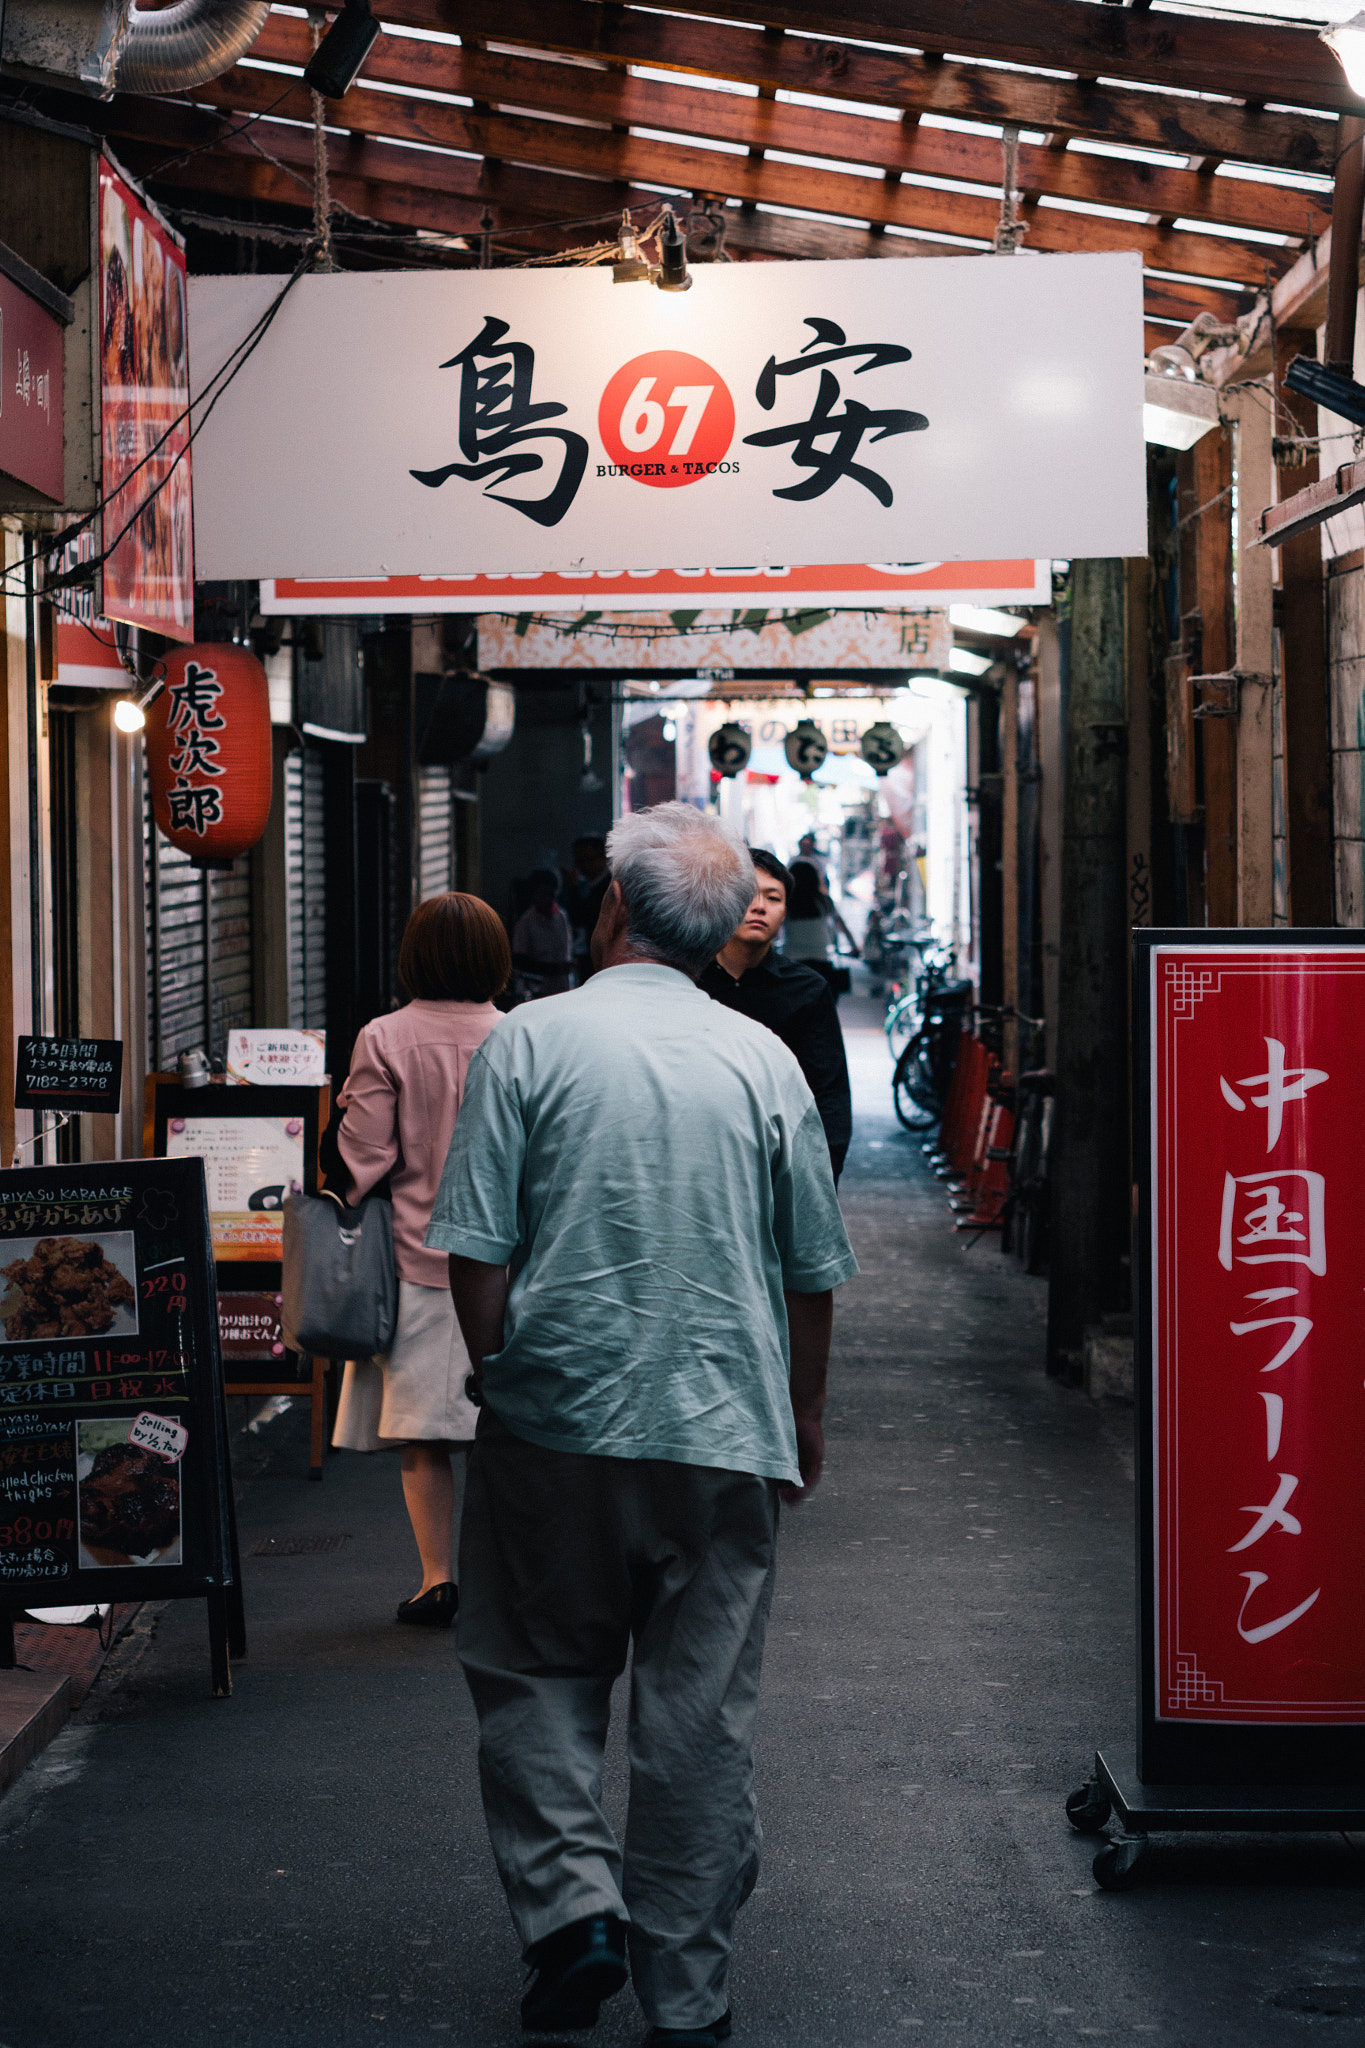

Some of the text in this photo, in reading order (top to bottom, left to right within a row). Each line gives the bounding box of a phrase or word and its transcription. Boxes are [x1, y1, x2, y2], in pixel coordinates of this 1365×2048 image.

[409, 316, 589, 527] 鳥
[618, 376, 715, 456] 67
[742, 317, 929, 508] 安
[596, 461, 740, 477] BURGER & TACOS
[900, 607, 931, 654] 店
[167, 661, 227, 837] 虎次郎
[25, 1073, 108, 1089] 7182-2378
[59, 1186, 134, 1201] KARAAGE
[141, 1272, 187, 1299] 220
[1217, 1036, 1330, 1644] 中国ラーメン
[134, 1427, 148, 1442] by
[139, 1415, 178, 1439] Selling
